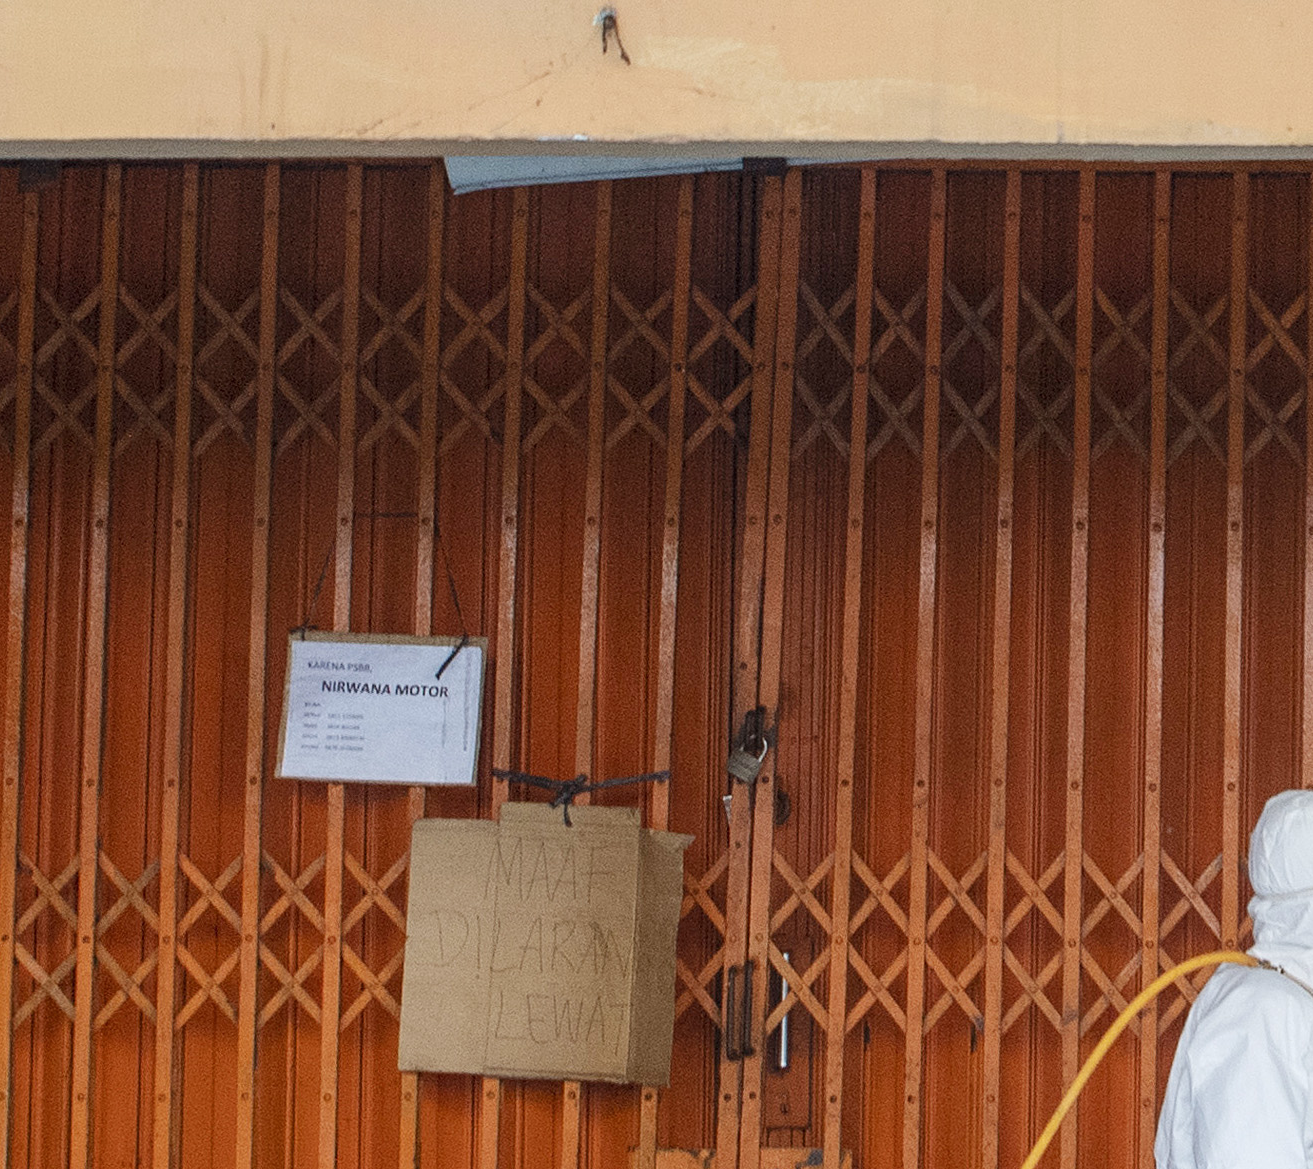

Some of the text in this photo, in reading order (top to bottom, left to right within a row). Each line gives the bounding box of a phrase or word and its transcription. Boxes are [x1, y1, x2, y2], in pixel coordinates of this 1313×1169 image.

[308, 661, 345, 671] KARENA
[322, 680, 448, 698] NIRWANA MOTOR
[484, 836, 614, 904] MAAF
[494, 989, 632, 1056] LEWAT
